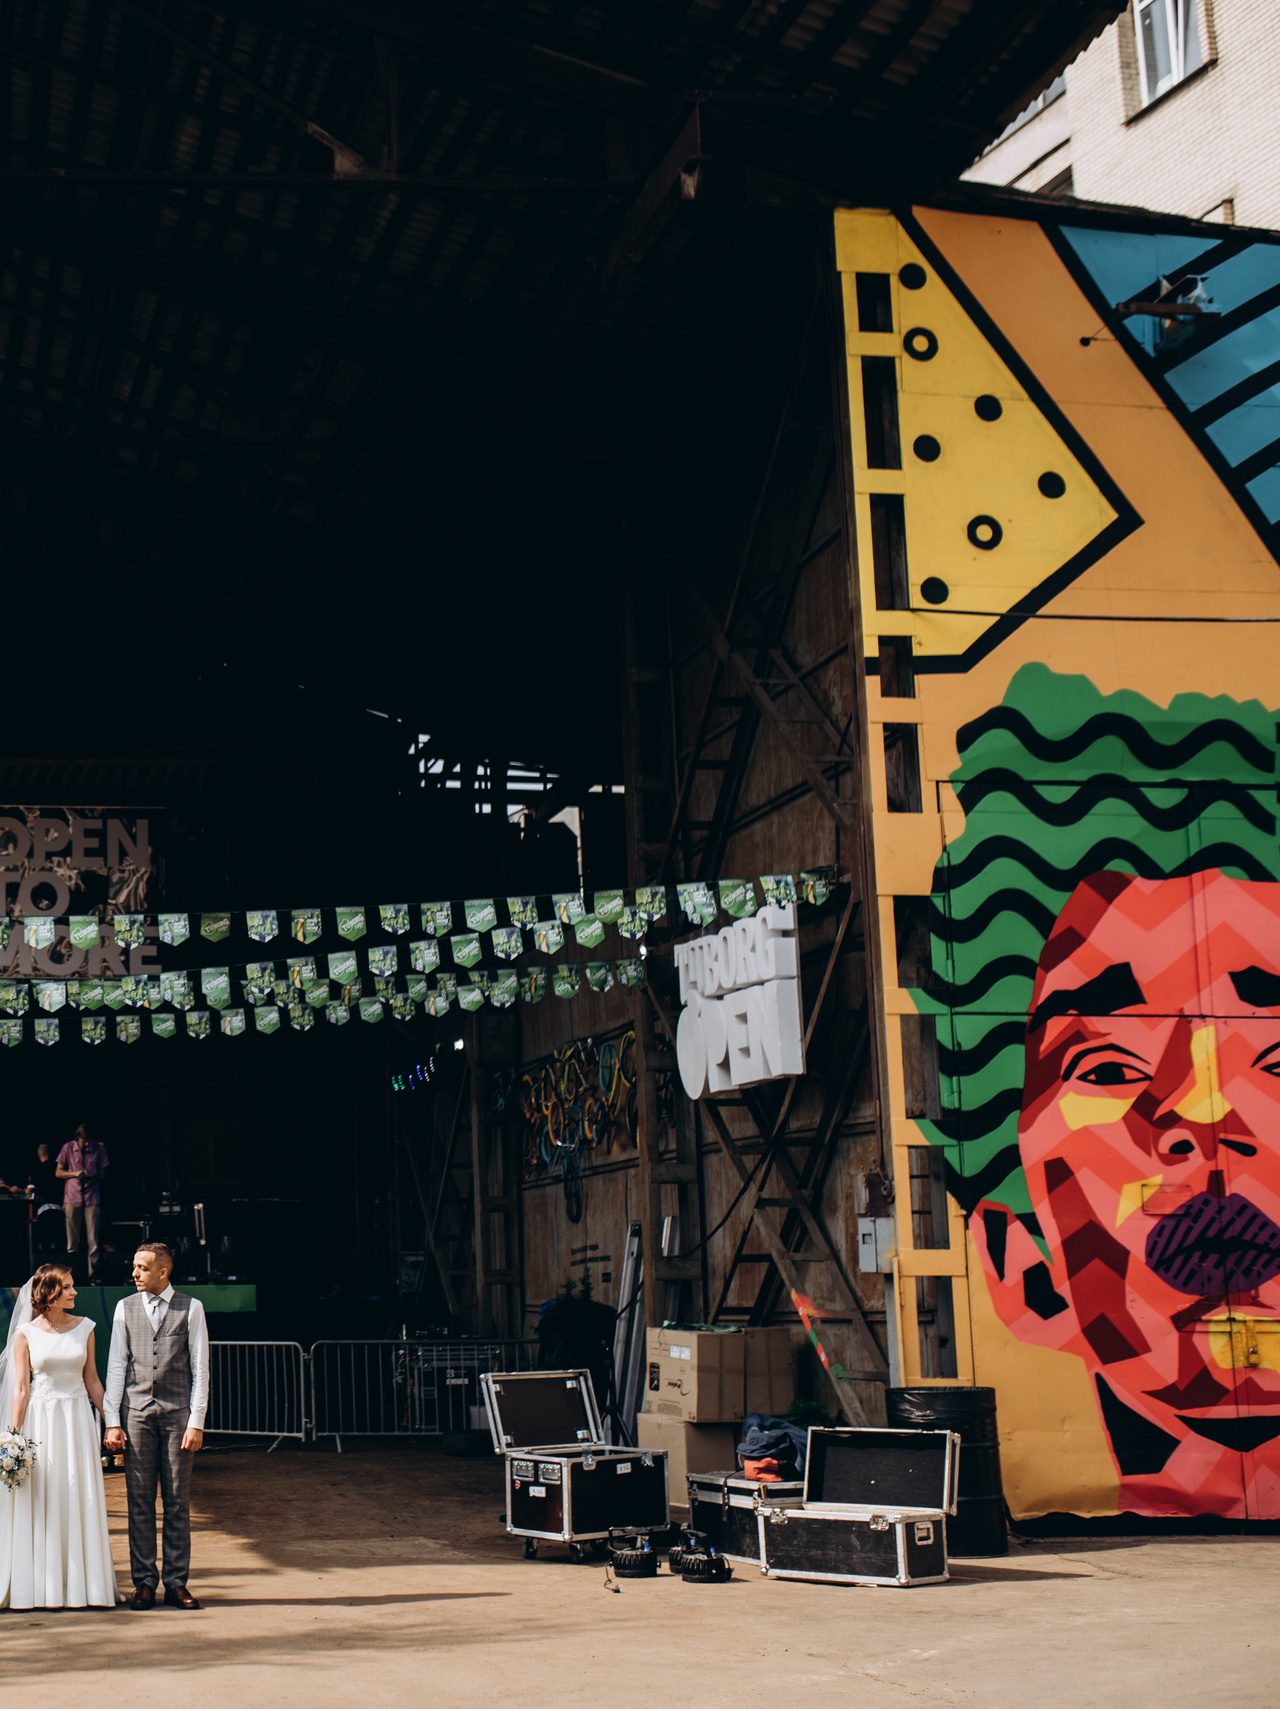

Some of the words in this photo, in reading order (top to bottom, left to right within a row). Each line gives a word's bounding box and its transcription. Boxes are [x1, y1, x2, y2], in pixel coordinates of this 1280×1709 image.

[470, 906, 493, 923] TUBORG
[599, 898, 620, 916] TUBORG
[205, 919, 230, 933] TUBORG
[342, 914, 364, 930] TUBORG
[579, 921, 603, 939] TUBORG
[74, 924, 98, 940] TUBORG
[456, 940, 479, 958] TUBORG
[673, 905, 798, 1006] TUBORG
[333, 958, 355, 975] TUBORG
[205, 974, 228, 990] TUBORG
[82, 987, 103, 1001] TUBORG
[676, 979, 806, 1100] OPEN
